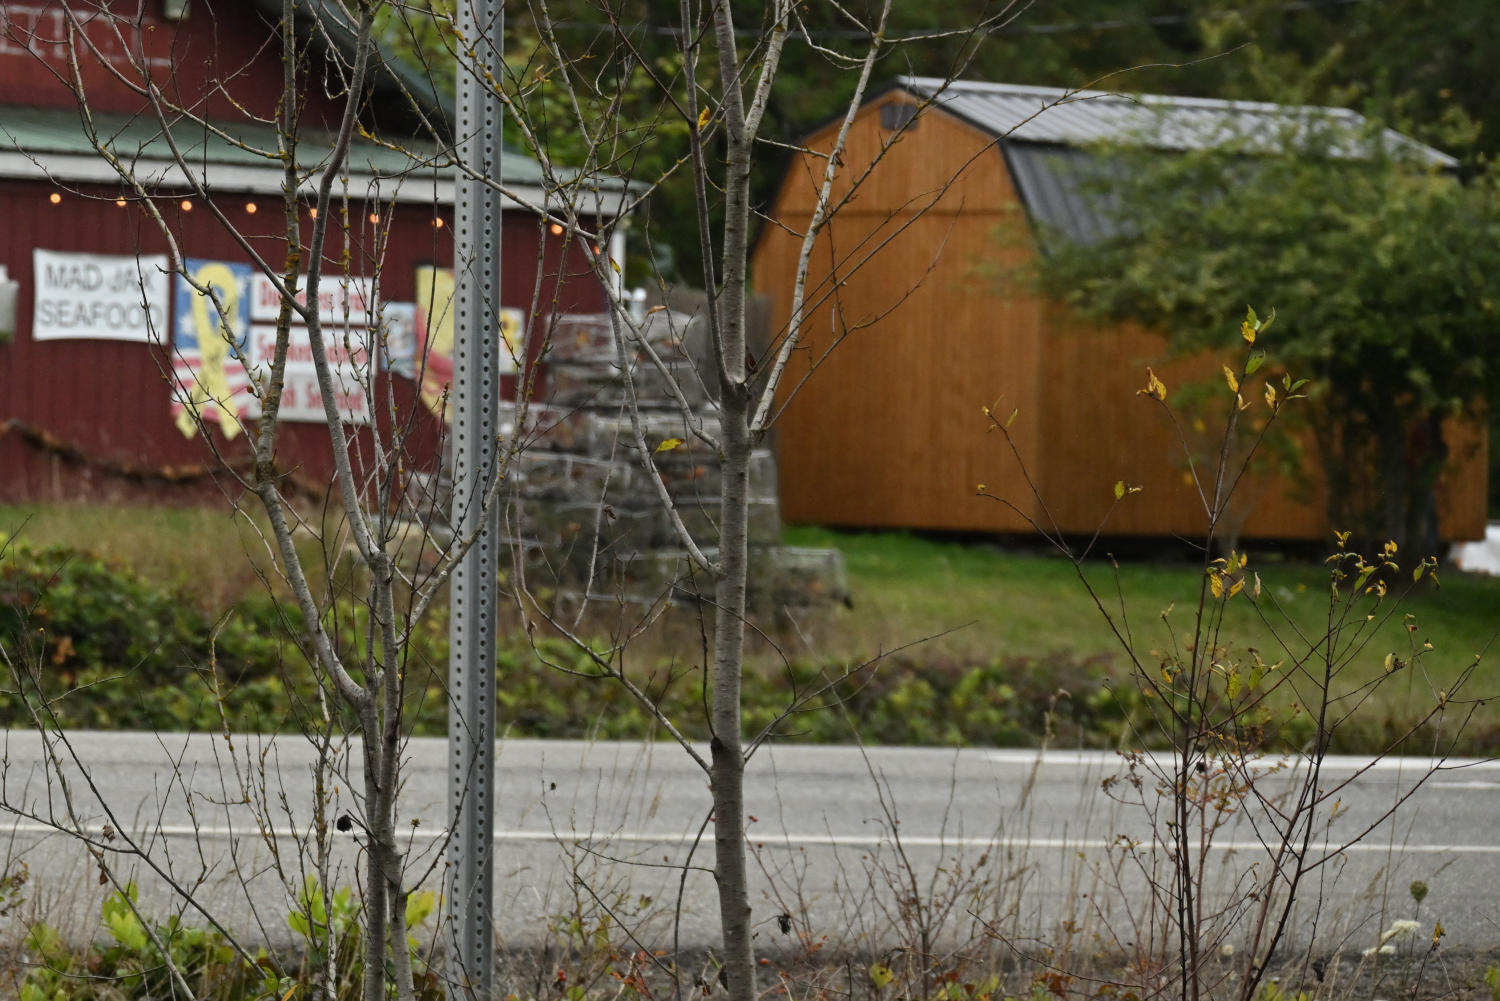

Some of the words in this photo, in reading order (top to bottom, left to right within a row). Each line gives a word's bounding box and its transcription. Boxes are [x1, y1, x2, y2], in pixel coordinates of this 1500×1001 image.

[45, 263, 103, 292] MAD
[107, 265, 155, 293] JAX
[39, 299, 163, 330] SEAFOOD
